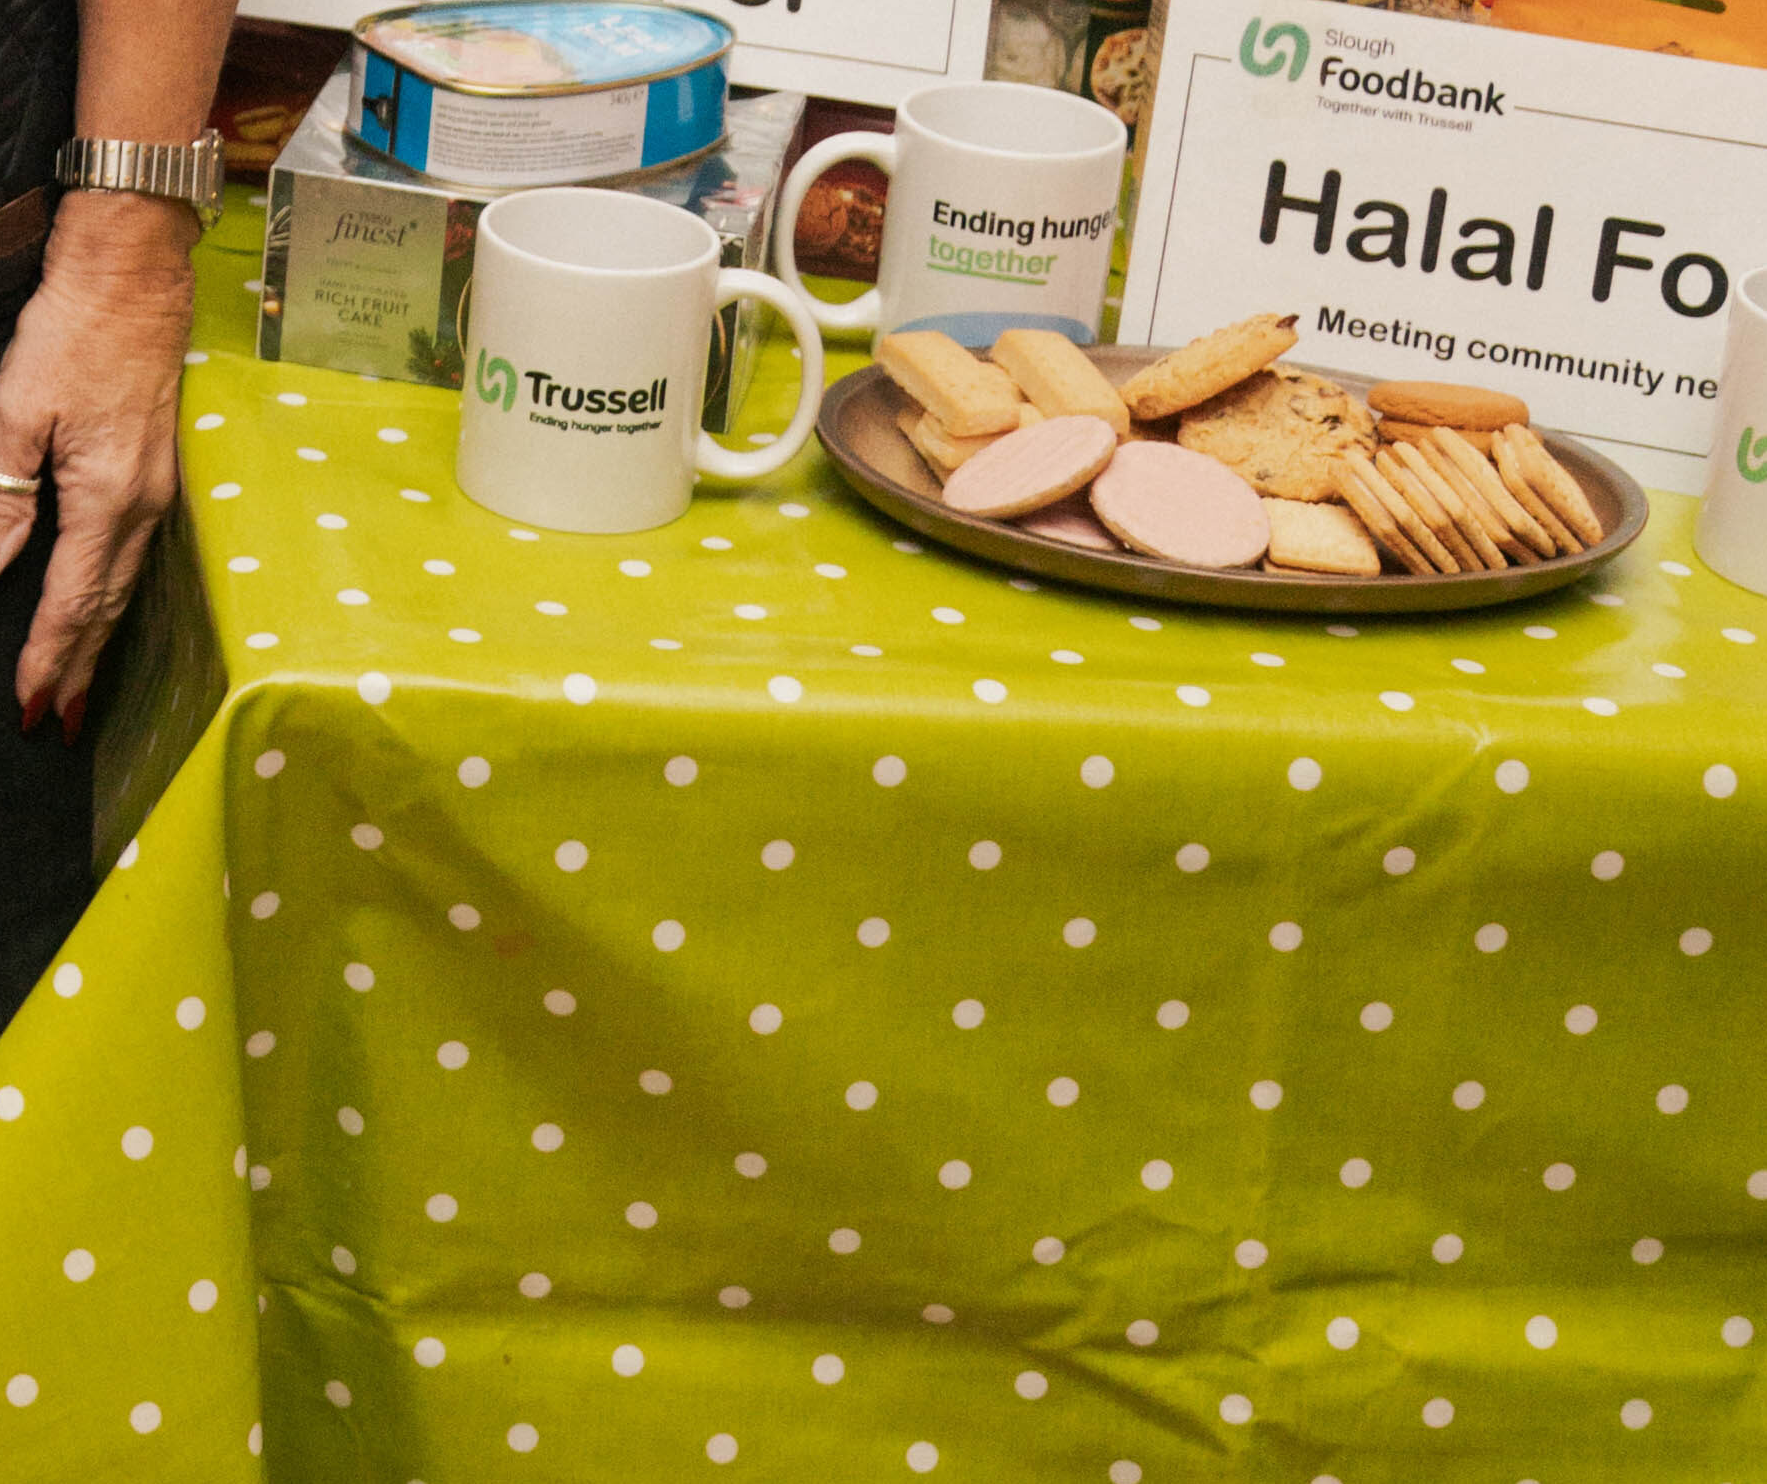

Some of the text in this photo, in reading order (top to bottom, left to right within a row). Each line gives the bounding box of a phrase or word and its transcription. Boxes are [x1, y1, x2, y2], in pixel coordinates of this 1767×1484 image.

[1324, 28, 1396, 59] Slough
[1319, 55, 1506, 117] Foodbank
[1316, 95, 1473, 133] Together with Trussell
[325, 213, 407, 247] finest
[932, 199, 1035, 246] Ending
[1259, 159, 1731, 319] Halal Fo
[928, 234, 1059, 275] together
[315, 289, 410, 317] RICH FRUIT
[338, 308, 384, 328] CAKE
[1316, 306, 1457, 362] Meeting
[1465, 337, 1666, 397] community
[524, 370, 668, 415] Trussell
[529, 411, 663, 435] Ending hunger together
